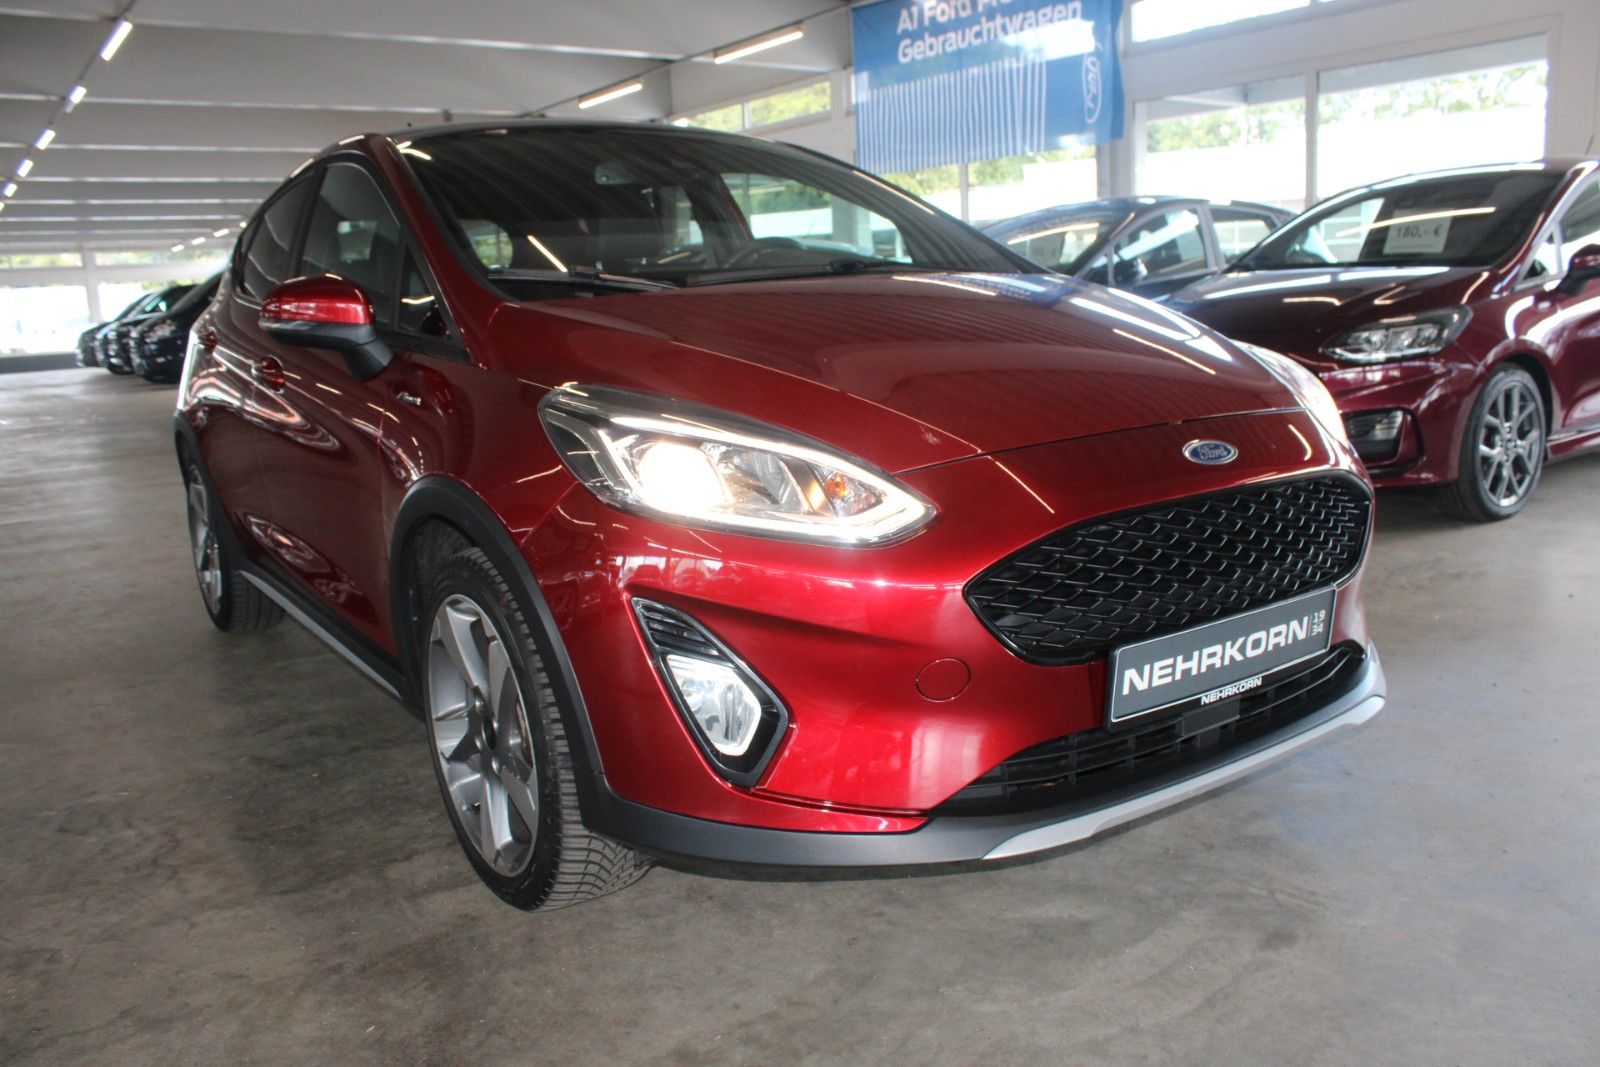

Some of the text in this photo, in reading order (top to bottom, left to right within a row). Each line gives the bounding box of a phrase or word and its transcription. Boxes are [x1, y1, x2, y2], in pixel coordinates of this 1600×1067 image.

[923, 0, 972, 27] Ford
[898, 1, 1082, 63] Gebrauchtwagen
[1312, 609, 1326, 623] 19
[1121, 615, 1309, 696] NEHRKORN
[1200, 676, 1262, 706] NEHRKORN
